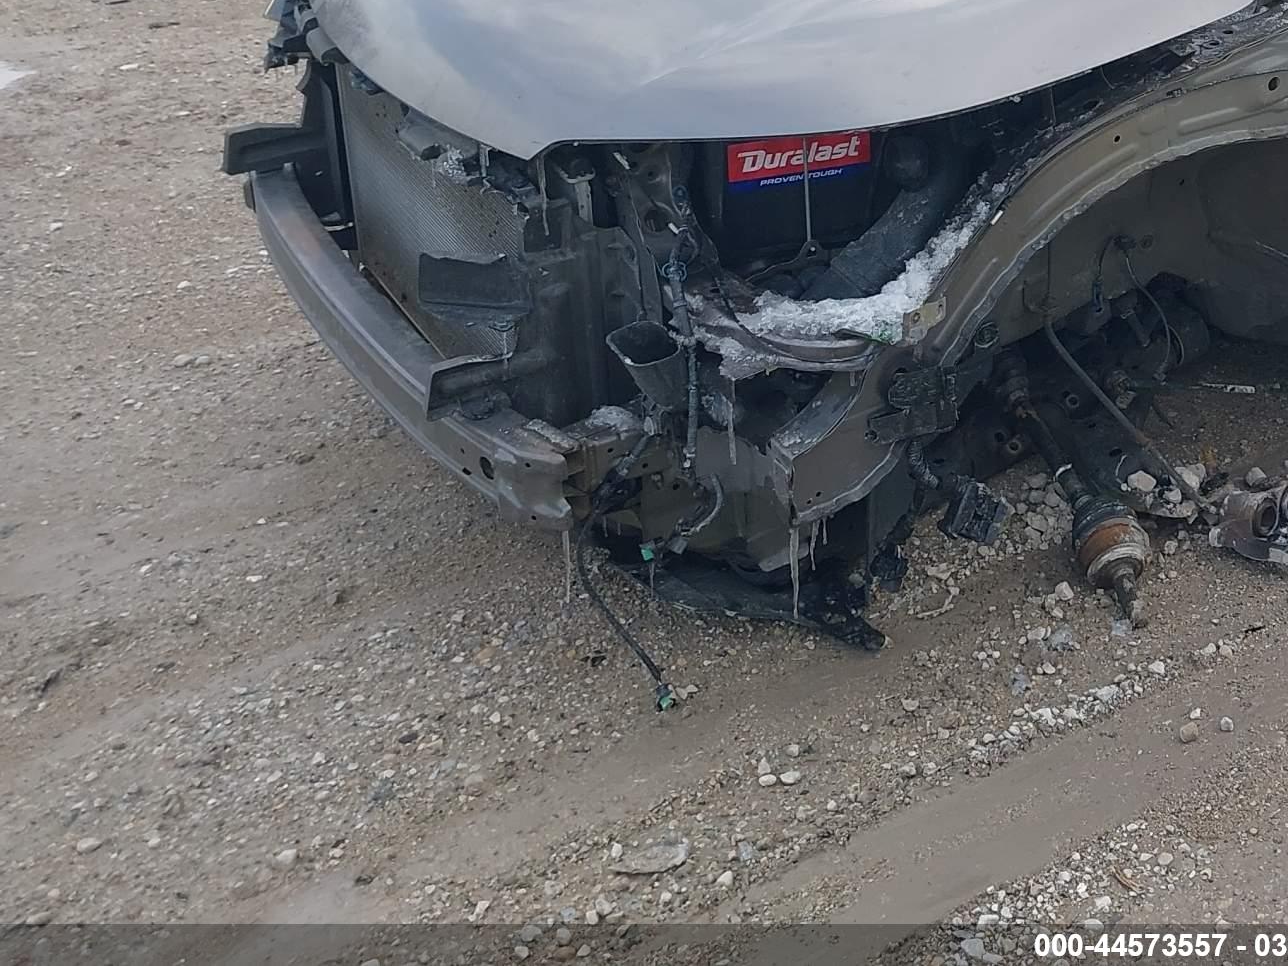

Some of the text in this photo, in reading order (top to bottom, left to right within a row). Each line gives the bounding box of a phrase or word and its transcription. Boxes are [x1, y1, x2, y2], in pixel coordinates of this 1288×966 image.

[737, 135, 861, 173] Duralast
[760, 168, 844, 187] PROVEN TOUGH
